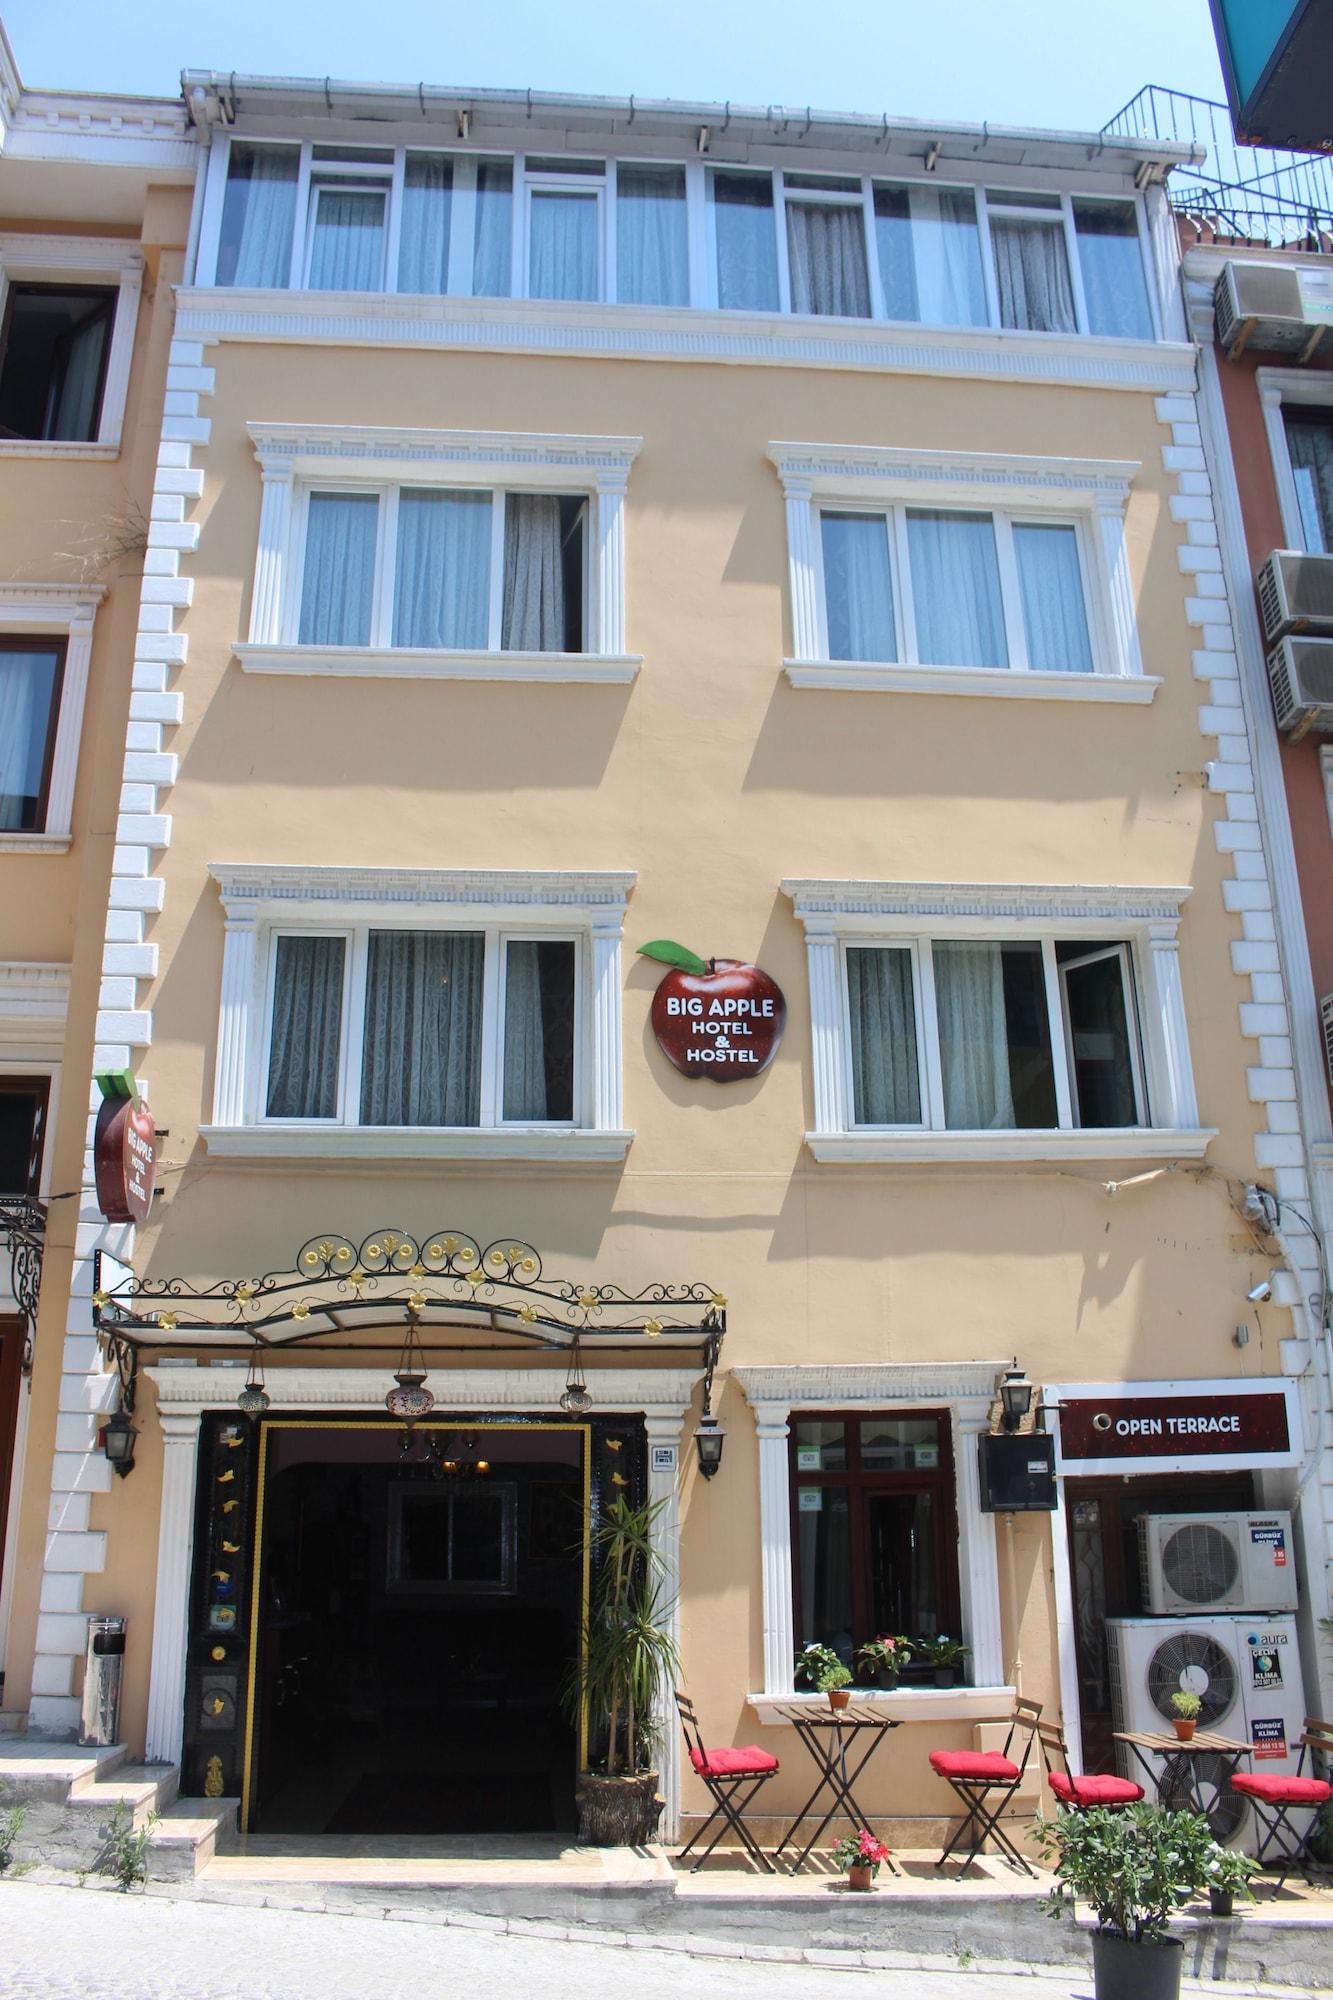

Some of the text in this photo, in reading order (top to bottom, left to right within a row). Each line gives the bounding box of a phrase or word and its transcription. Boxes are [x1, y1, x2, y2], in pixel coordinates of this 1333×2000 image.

[667, 997, 774, 1017] BIG APPLE
[692, 1021, 752, 1035] HOTEL
[714, 1035, 730, 1048] &
[686, 1049, 759, 1062] HOSTEL
[136, 1136, 153, 1163] APPLE
[131, 1153, 146, 1176] HOTEL
[1116, 1416, 1240, 1436] OPEN TERRACE
[1261, 1633, 1288, 1645] aura
